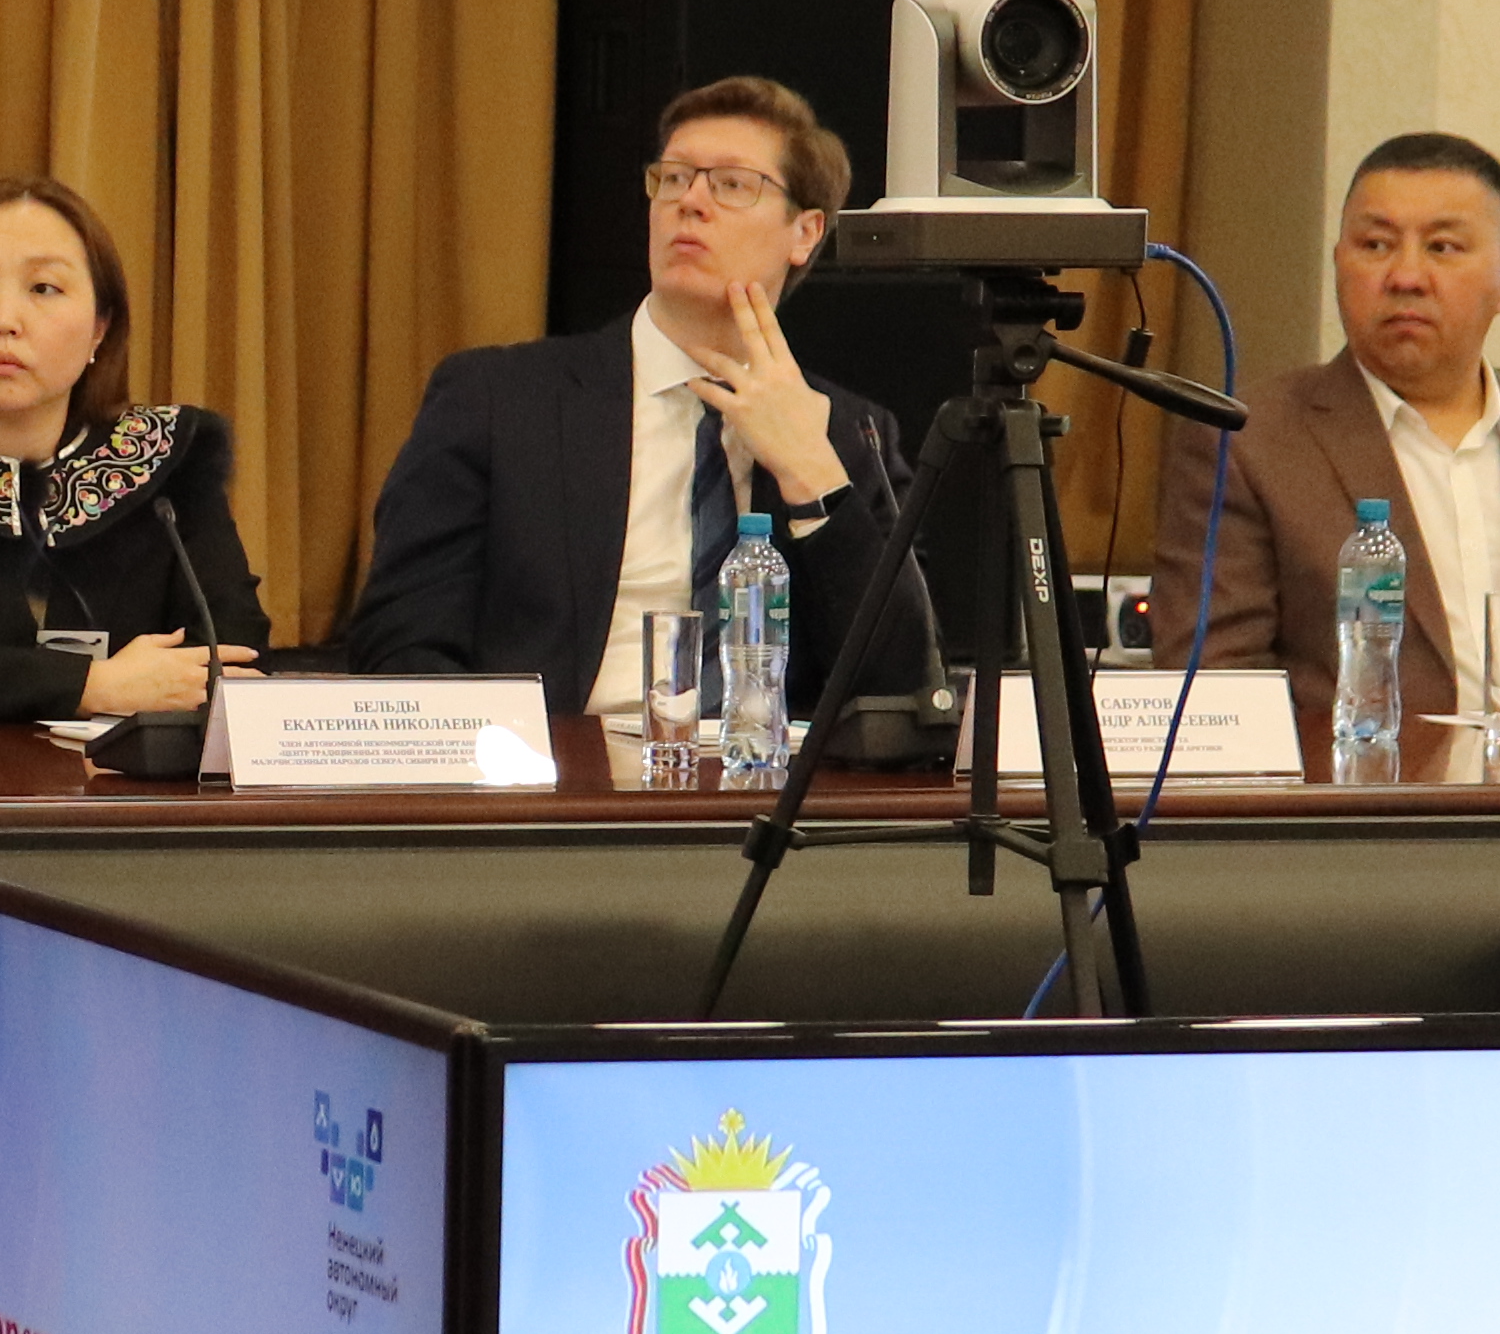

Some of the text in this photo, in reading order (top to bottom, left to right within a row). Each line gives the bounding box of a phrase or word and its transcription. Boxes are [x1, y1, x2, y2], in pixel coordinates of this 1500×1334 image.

[1028, 537, 1050, 603] DEXP
[353, 700, 421, 715] БЕЛЬДЫ
[1100, 697, 1173, 710] САБУРОВ
[282, 718, 494, 732] ЕКАТЕРИНА НИКОЛАЕВНА
[328, 1222, 384, 1266] Ненецкий
[327, 1256, 399, 1304] автономный
[326, 1289, 358, 1324] округ
